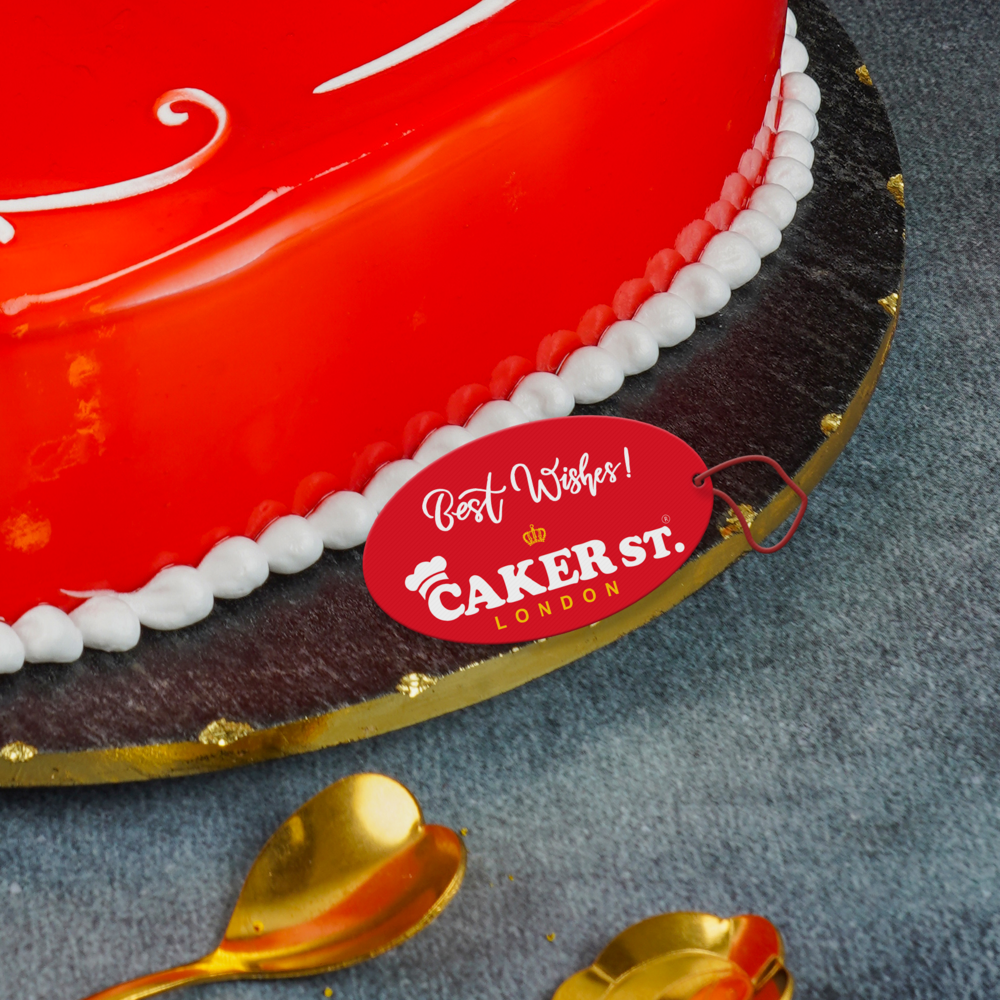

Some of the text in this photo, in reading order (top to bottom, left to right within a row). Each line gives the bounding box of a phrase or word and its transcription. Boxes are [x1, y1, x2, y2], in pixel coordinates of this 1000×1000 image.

[421, 447, 632, 532] Best Wishes!
[427, 525, 686, 622] CAKER ST.
[494, 580, 620, 630] LONDON
